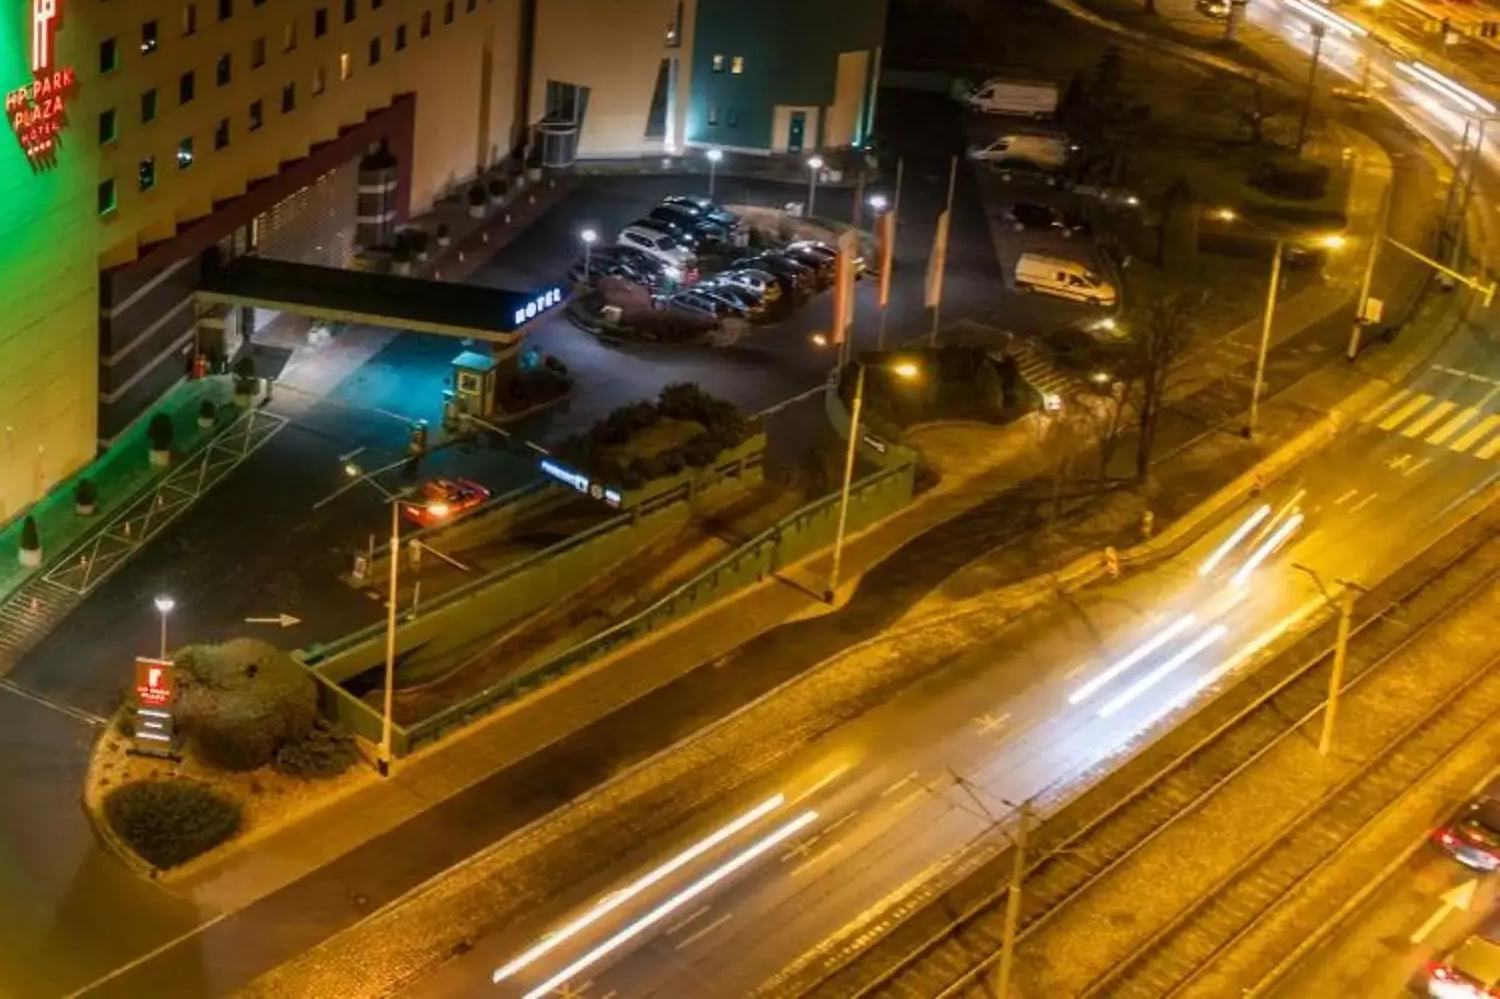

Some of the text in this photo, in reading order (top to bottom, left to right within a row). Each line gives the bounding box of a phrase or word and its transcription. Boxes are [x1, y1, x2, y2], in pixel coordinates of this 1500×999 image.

[33, 68, 75, 97] PARK
[14, 97, 64, 130] PLAZA
[21, 124, 60, 145] HOTEL
